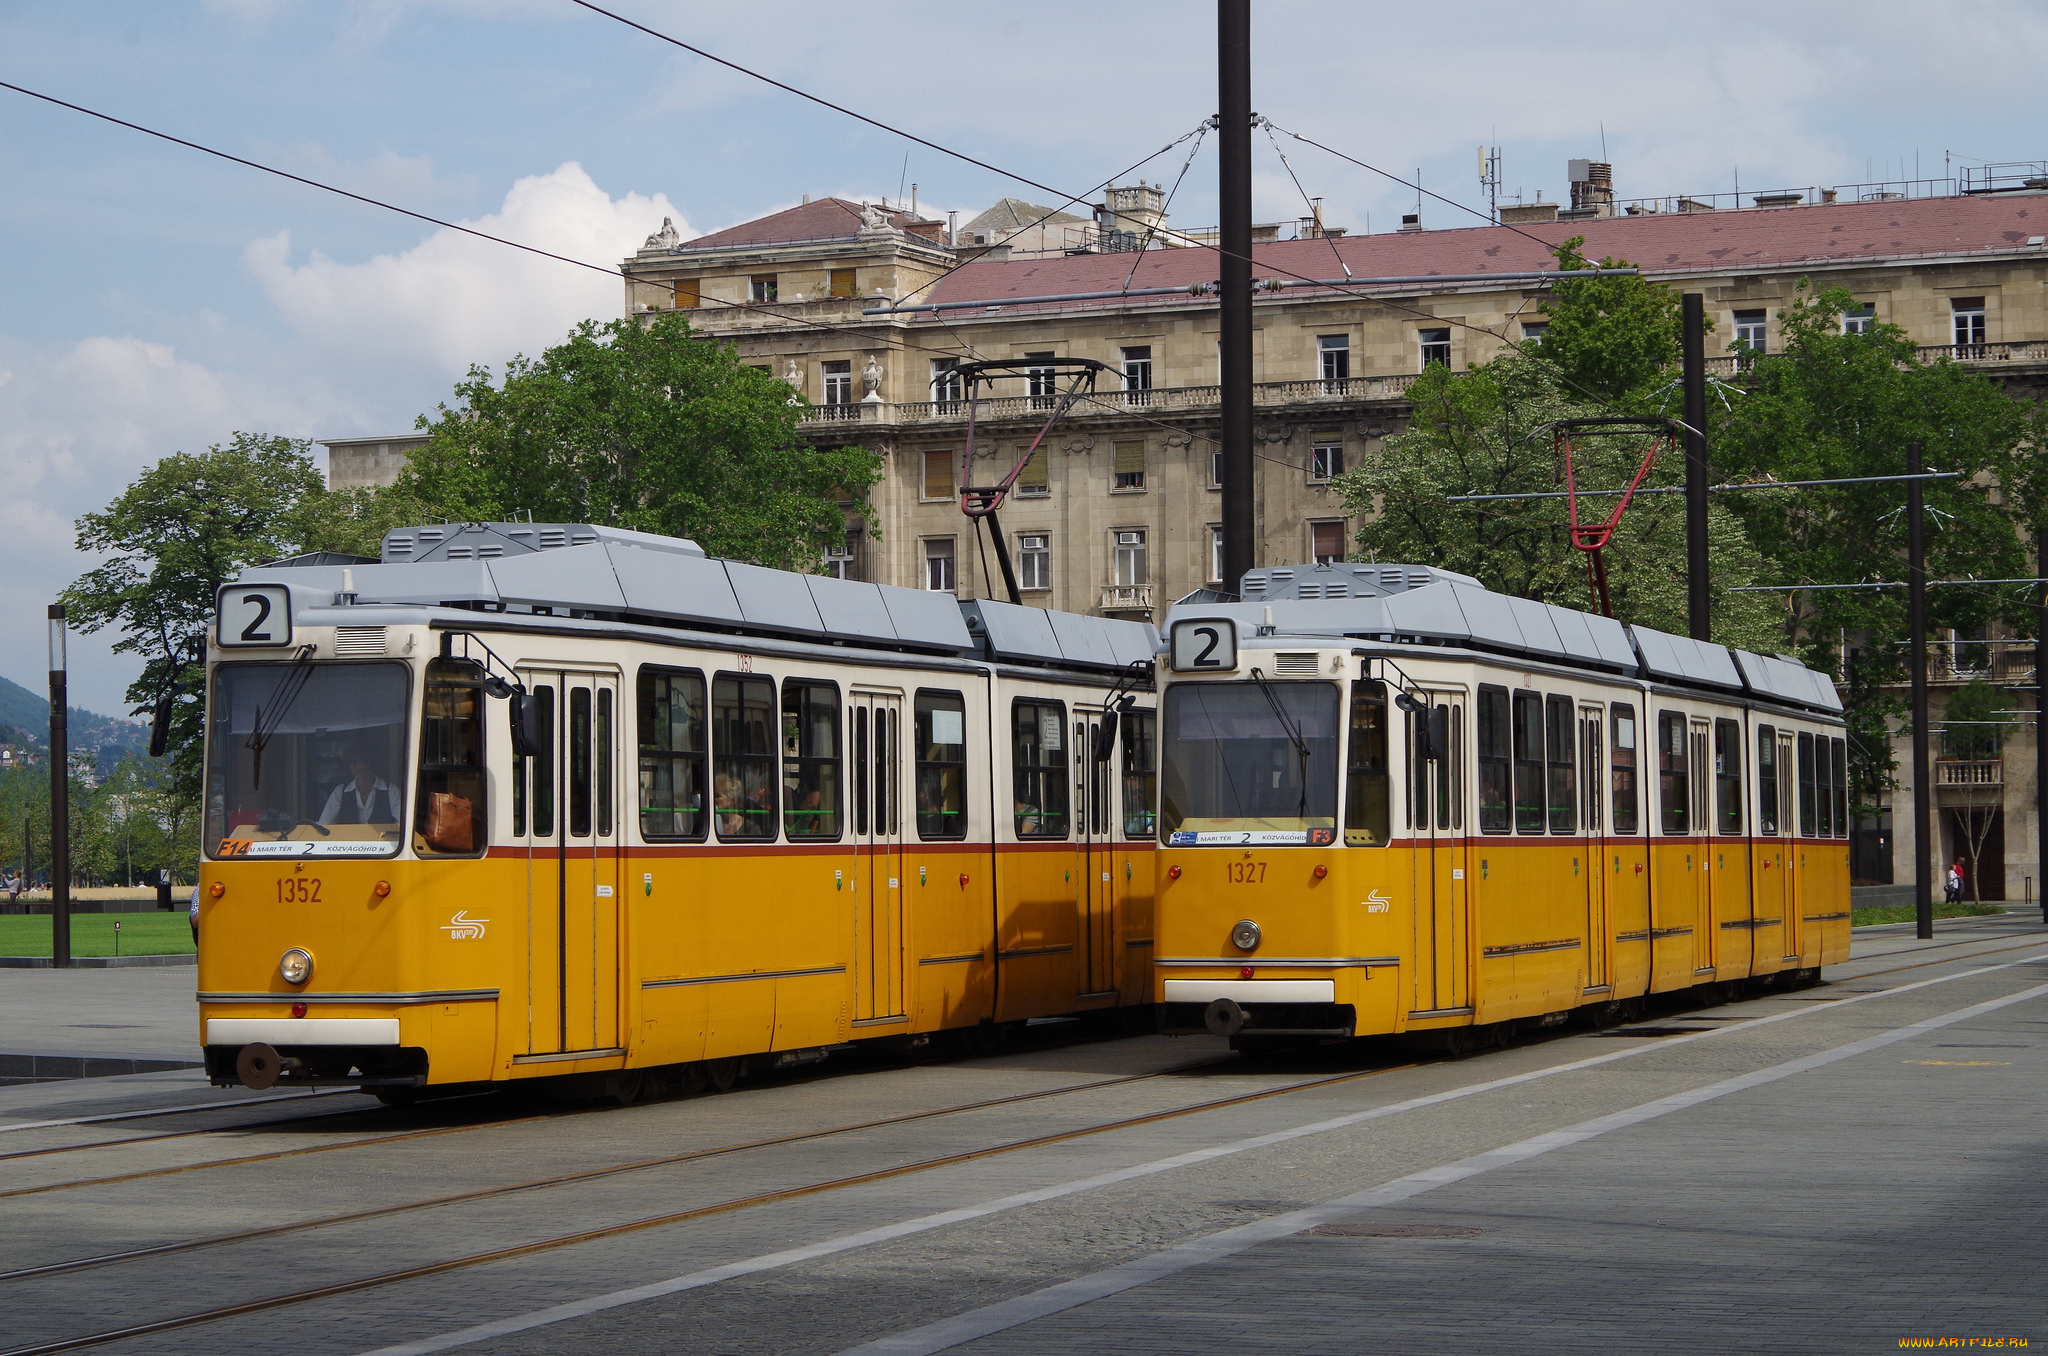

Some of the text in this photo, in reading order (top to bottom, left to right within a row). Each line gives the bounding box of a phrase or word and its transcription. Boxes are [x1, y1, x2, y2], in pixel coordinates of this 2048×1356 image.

[241, 594, 271, 641] 2
[1194, 627, 1220, 666] 2
[737, 654, 753, 673] 1352
[1240, 832, 1251, 844] 2
[1312, 829, 1331, 843] F3
[217, 841, 251, 856] F14
[301, 843, 315, 855] 2
[1227, 862, 1268, 884] 1327
[276, 878, 322, 904] 1352
[451, 930, 466, 939] BKV
